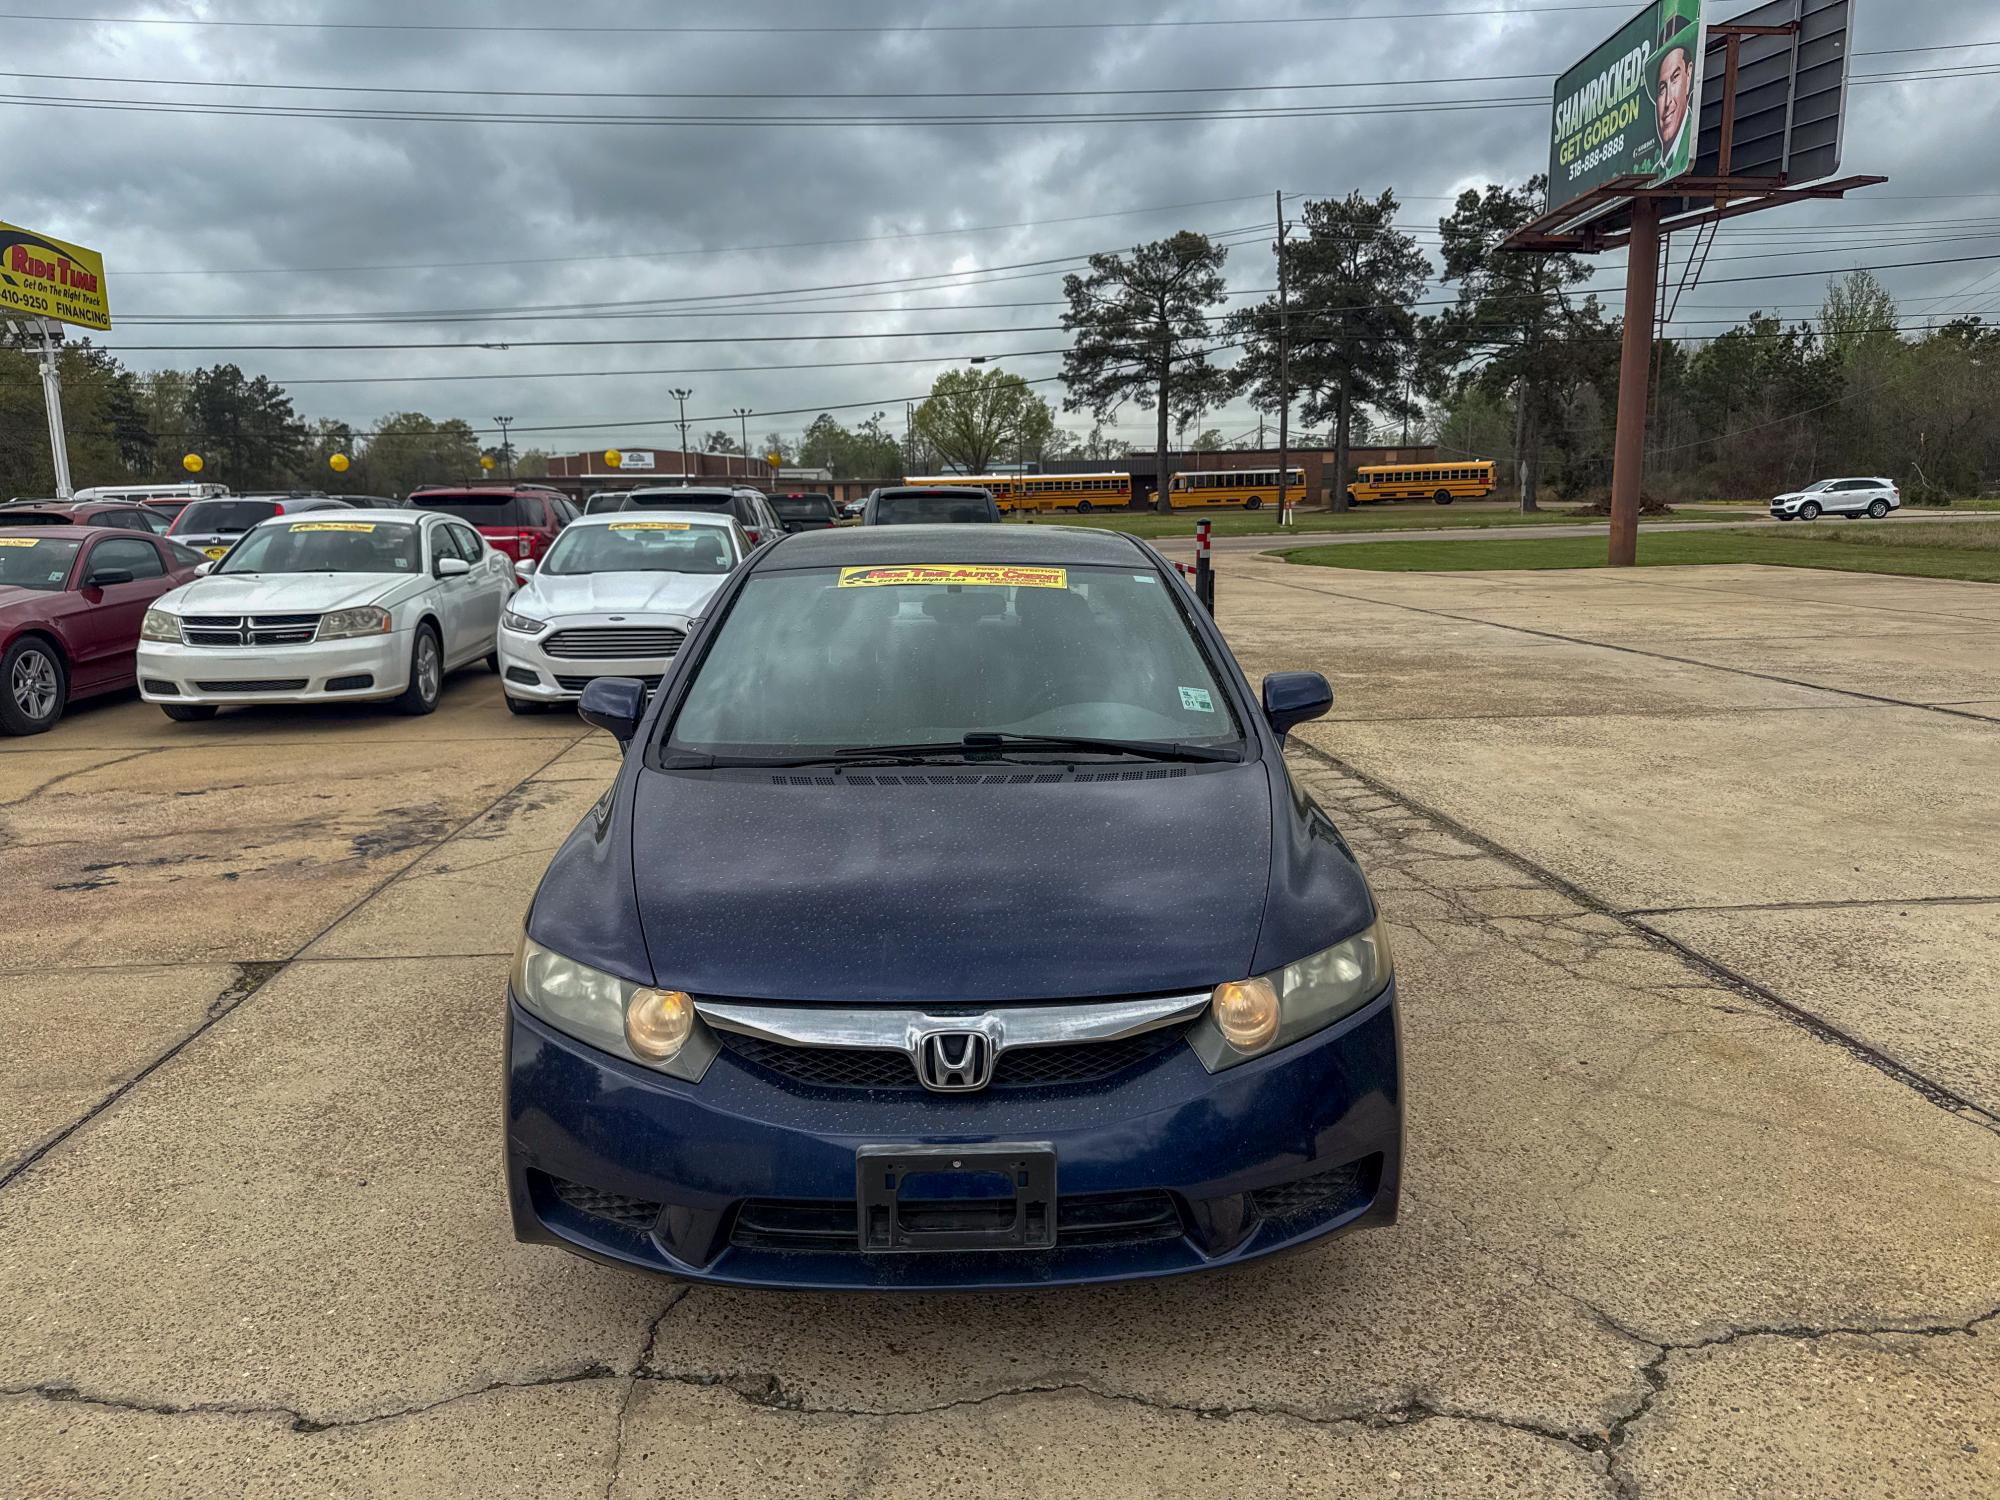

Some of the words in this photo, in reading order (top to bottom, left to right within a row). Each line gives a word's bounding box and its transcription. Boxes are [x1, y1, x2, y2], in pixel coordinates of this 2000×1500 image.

[1555, 40, 1651, 143] SHAMROCKED?
[1559, 133, 1582, 166] GET
[1583, 95, 1640, 150] GORDON
[1568, 134, 1625, 181] 318-888-8888
[12, 245, 55, 281] RIDE
[57, 257, 97, 293] TIME
[23, 279, 36, 290] Get
[38, 282, 48, 293] On
[49, 285, 61, 297] The
[63, 288, 81, 303] Right
[82, 293, 101, 306] Track
[1, 288, 48, 311] 410-9250
[56, 301, 108, 325] FINANCING
[868, 570, 908, 578] RIDE
[911, 568, 951, 577] TIME
[1002, 571, 1062, 581] CREDIT
